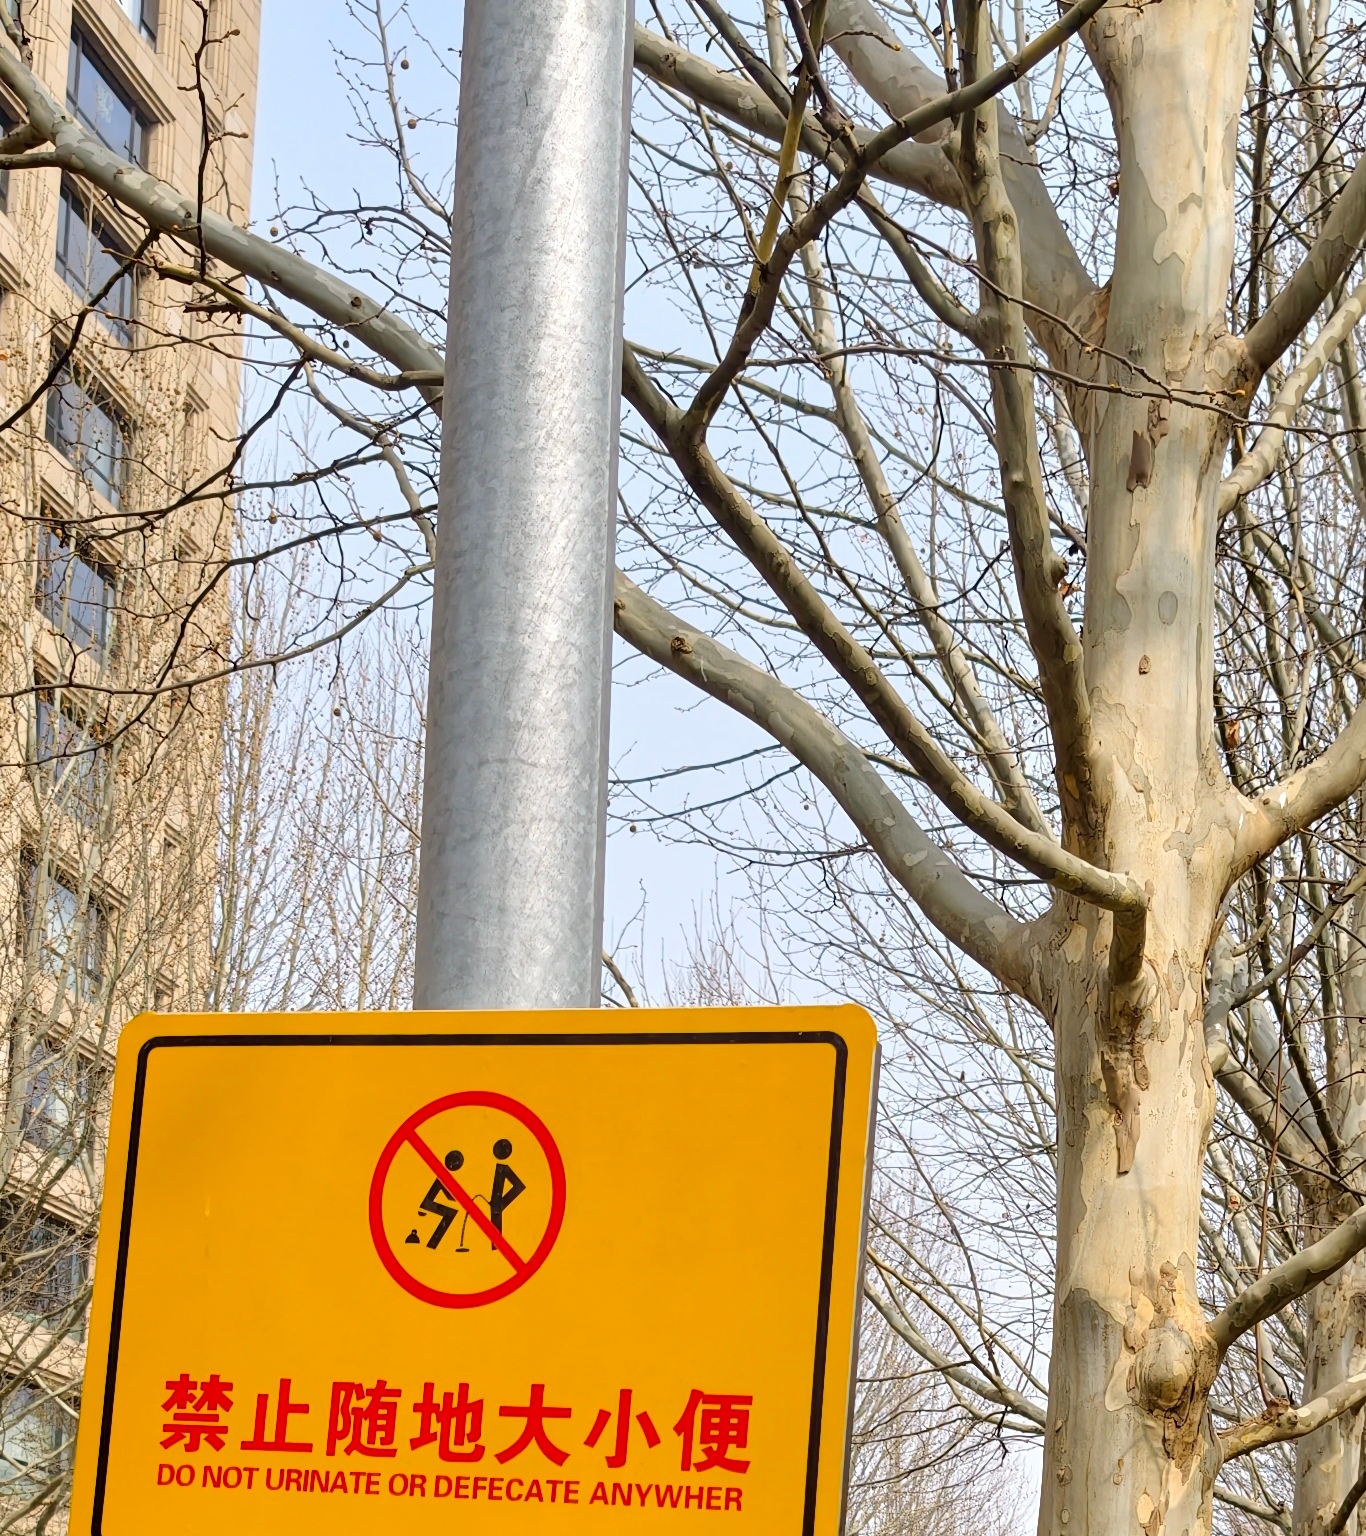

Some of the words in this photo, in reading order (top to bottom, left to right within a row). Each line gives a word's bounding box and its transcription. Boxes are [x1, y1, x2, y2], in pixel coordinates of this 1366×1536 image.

[158, 1373, 754, 1475] 禁止随地大小便
[156, 1463, 196, 1487] DO
[201, 1465, 260, 1490] NOT
[265, 1468, 382, 1496] URINATE
[388, 1473, 427, 1498] OR
[433, 1474, 581, 1505] DEFECATE
[588, 1481, 744, 1512] ANYWHER
